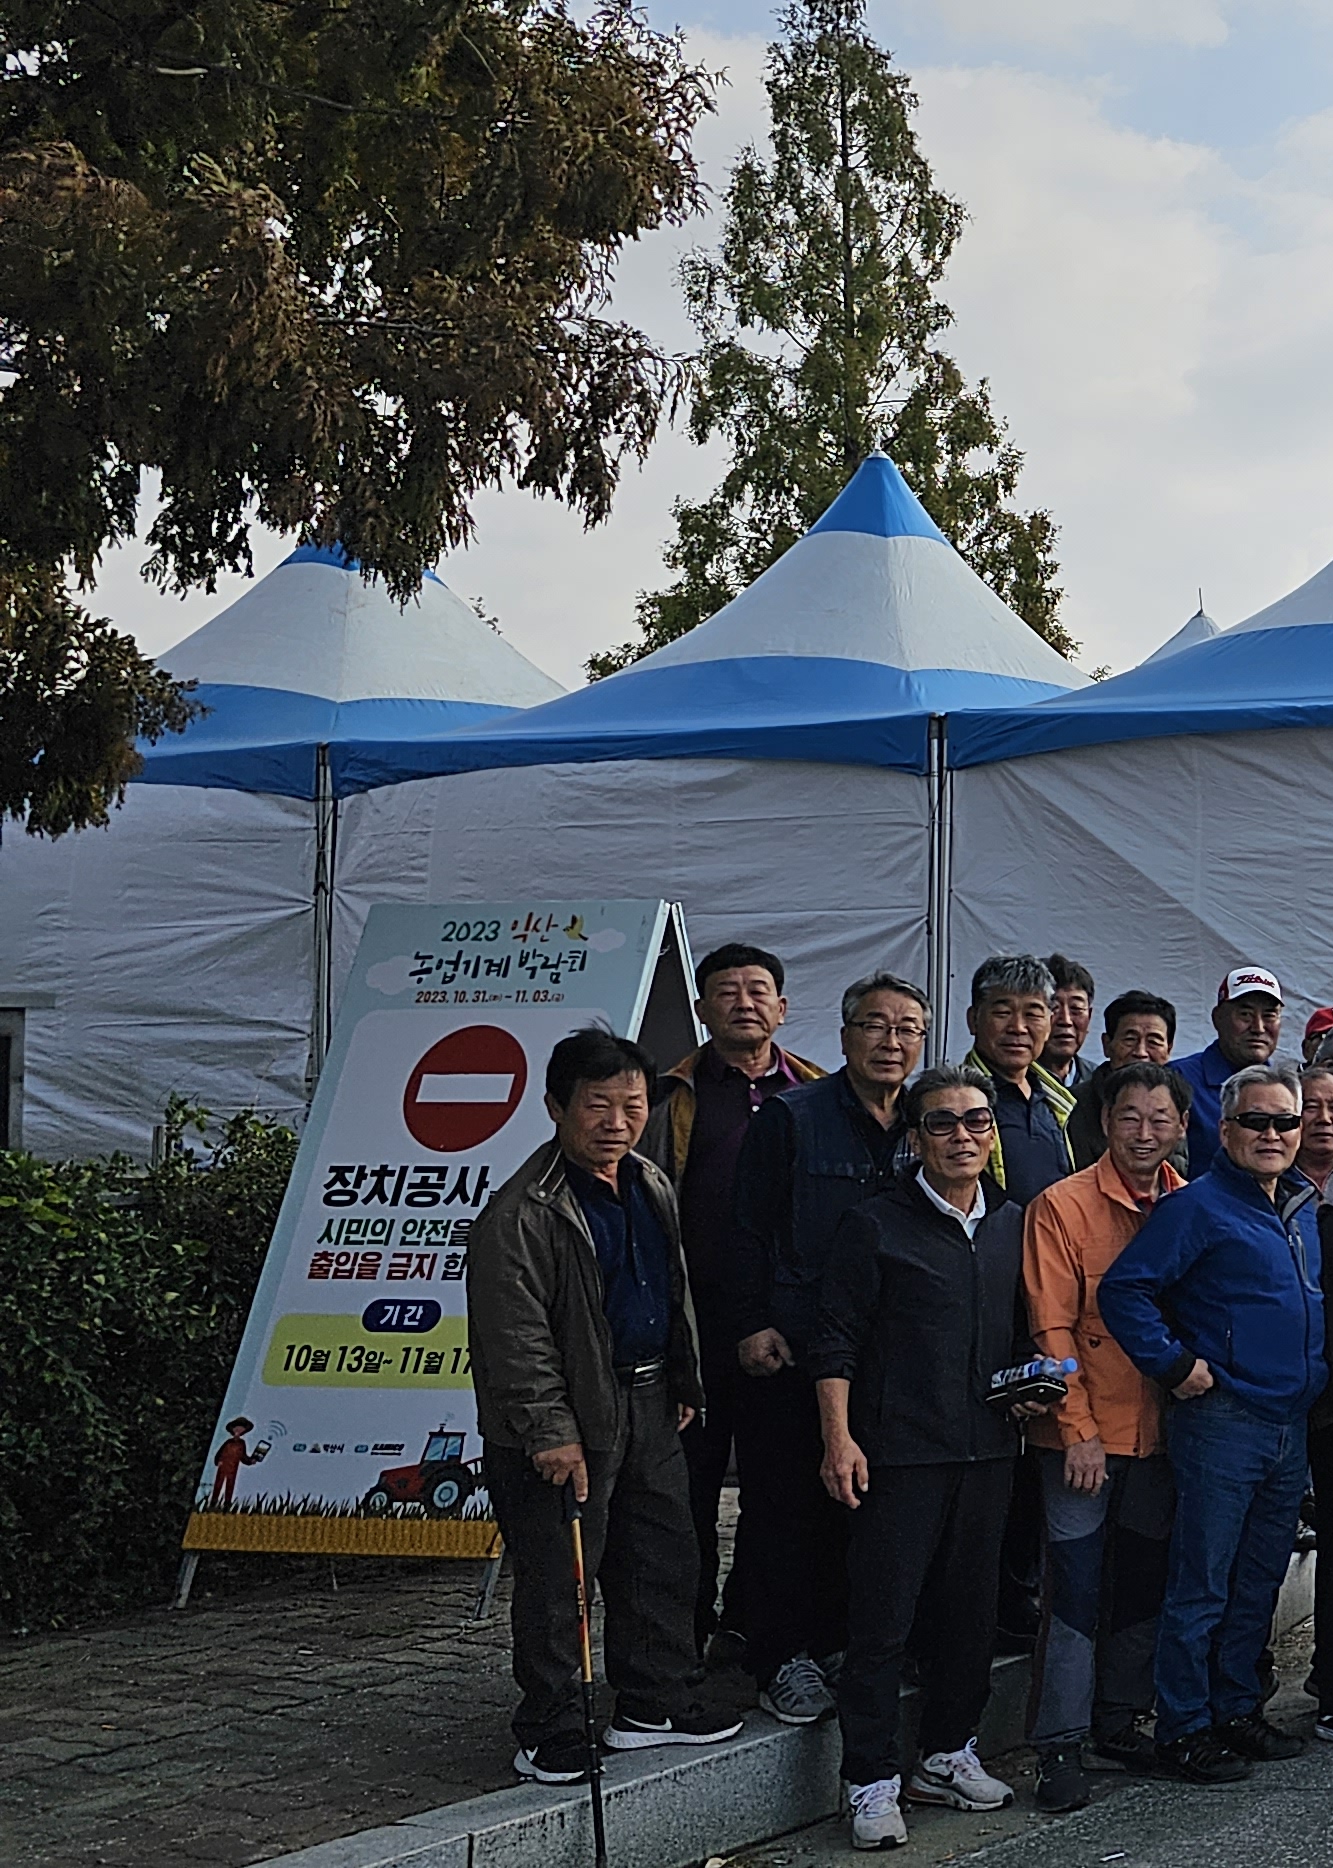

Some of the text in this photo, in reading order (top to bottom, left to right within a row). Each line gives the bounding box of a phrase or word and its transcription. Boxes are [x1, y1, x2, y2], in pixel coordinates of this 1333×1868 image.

[441, 911, 559, 943] 2023 익산
[408, 948, 588, 985] 농업기계 박람회
[415, 990, 449, 1003] 2023.
[453, 990, 469, 1003] 10.
[515, 989, 529, 1003] 11.
[322, 1163, 497, 1208] 장치공사
[316, 1218, 474, 1247] 시민의 안전을
[307, 1251, 382, 1280] 출입을
[386, 1252, 438, 1280] 금지
[283, 1344, 331, 1373] 10월
[400, 1346, 445, 1375] 11월
